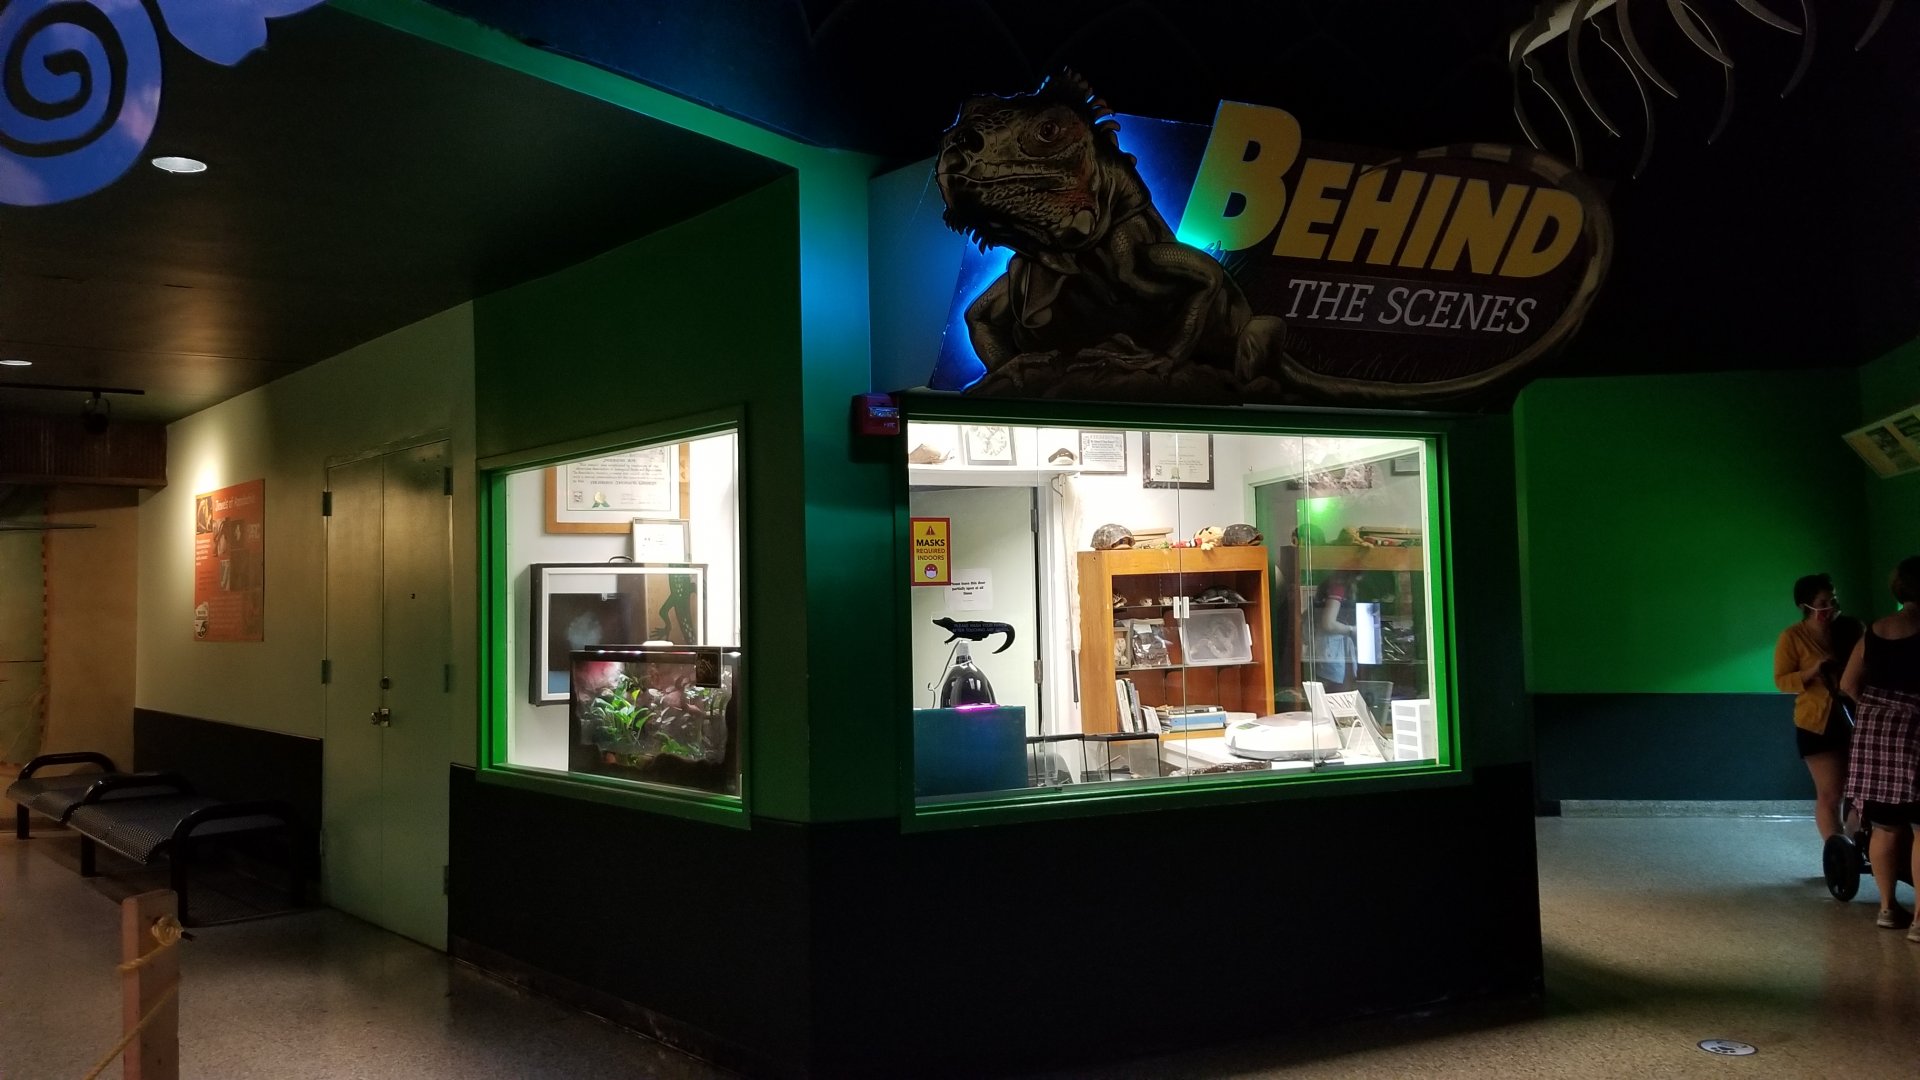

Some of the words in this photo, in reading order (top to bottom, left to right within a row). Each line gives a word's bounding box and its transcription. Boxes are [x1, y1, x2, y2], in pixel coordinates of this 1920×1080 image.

[1177, 99, 1584, 278] BEHIND
[1286, 279, 1374, 324] THE
[1377, 286, 1537, 334] SCENES
[916, 539, 945, 547] MASKS
